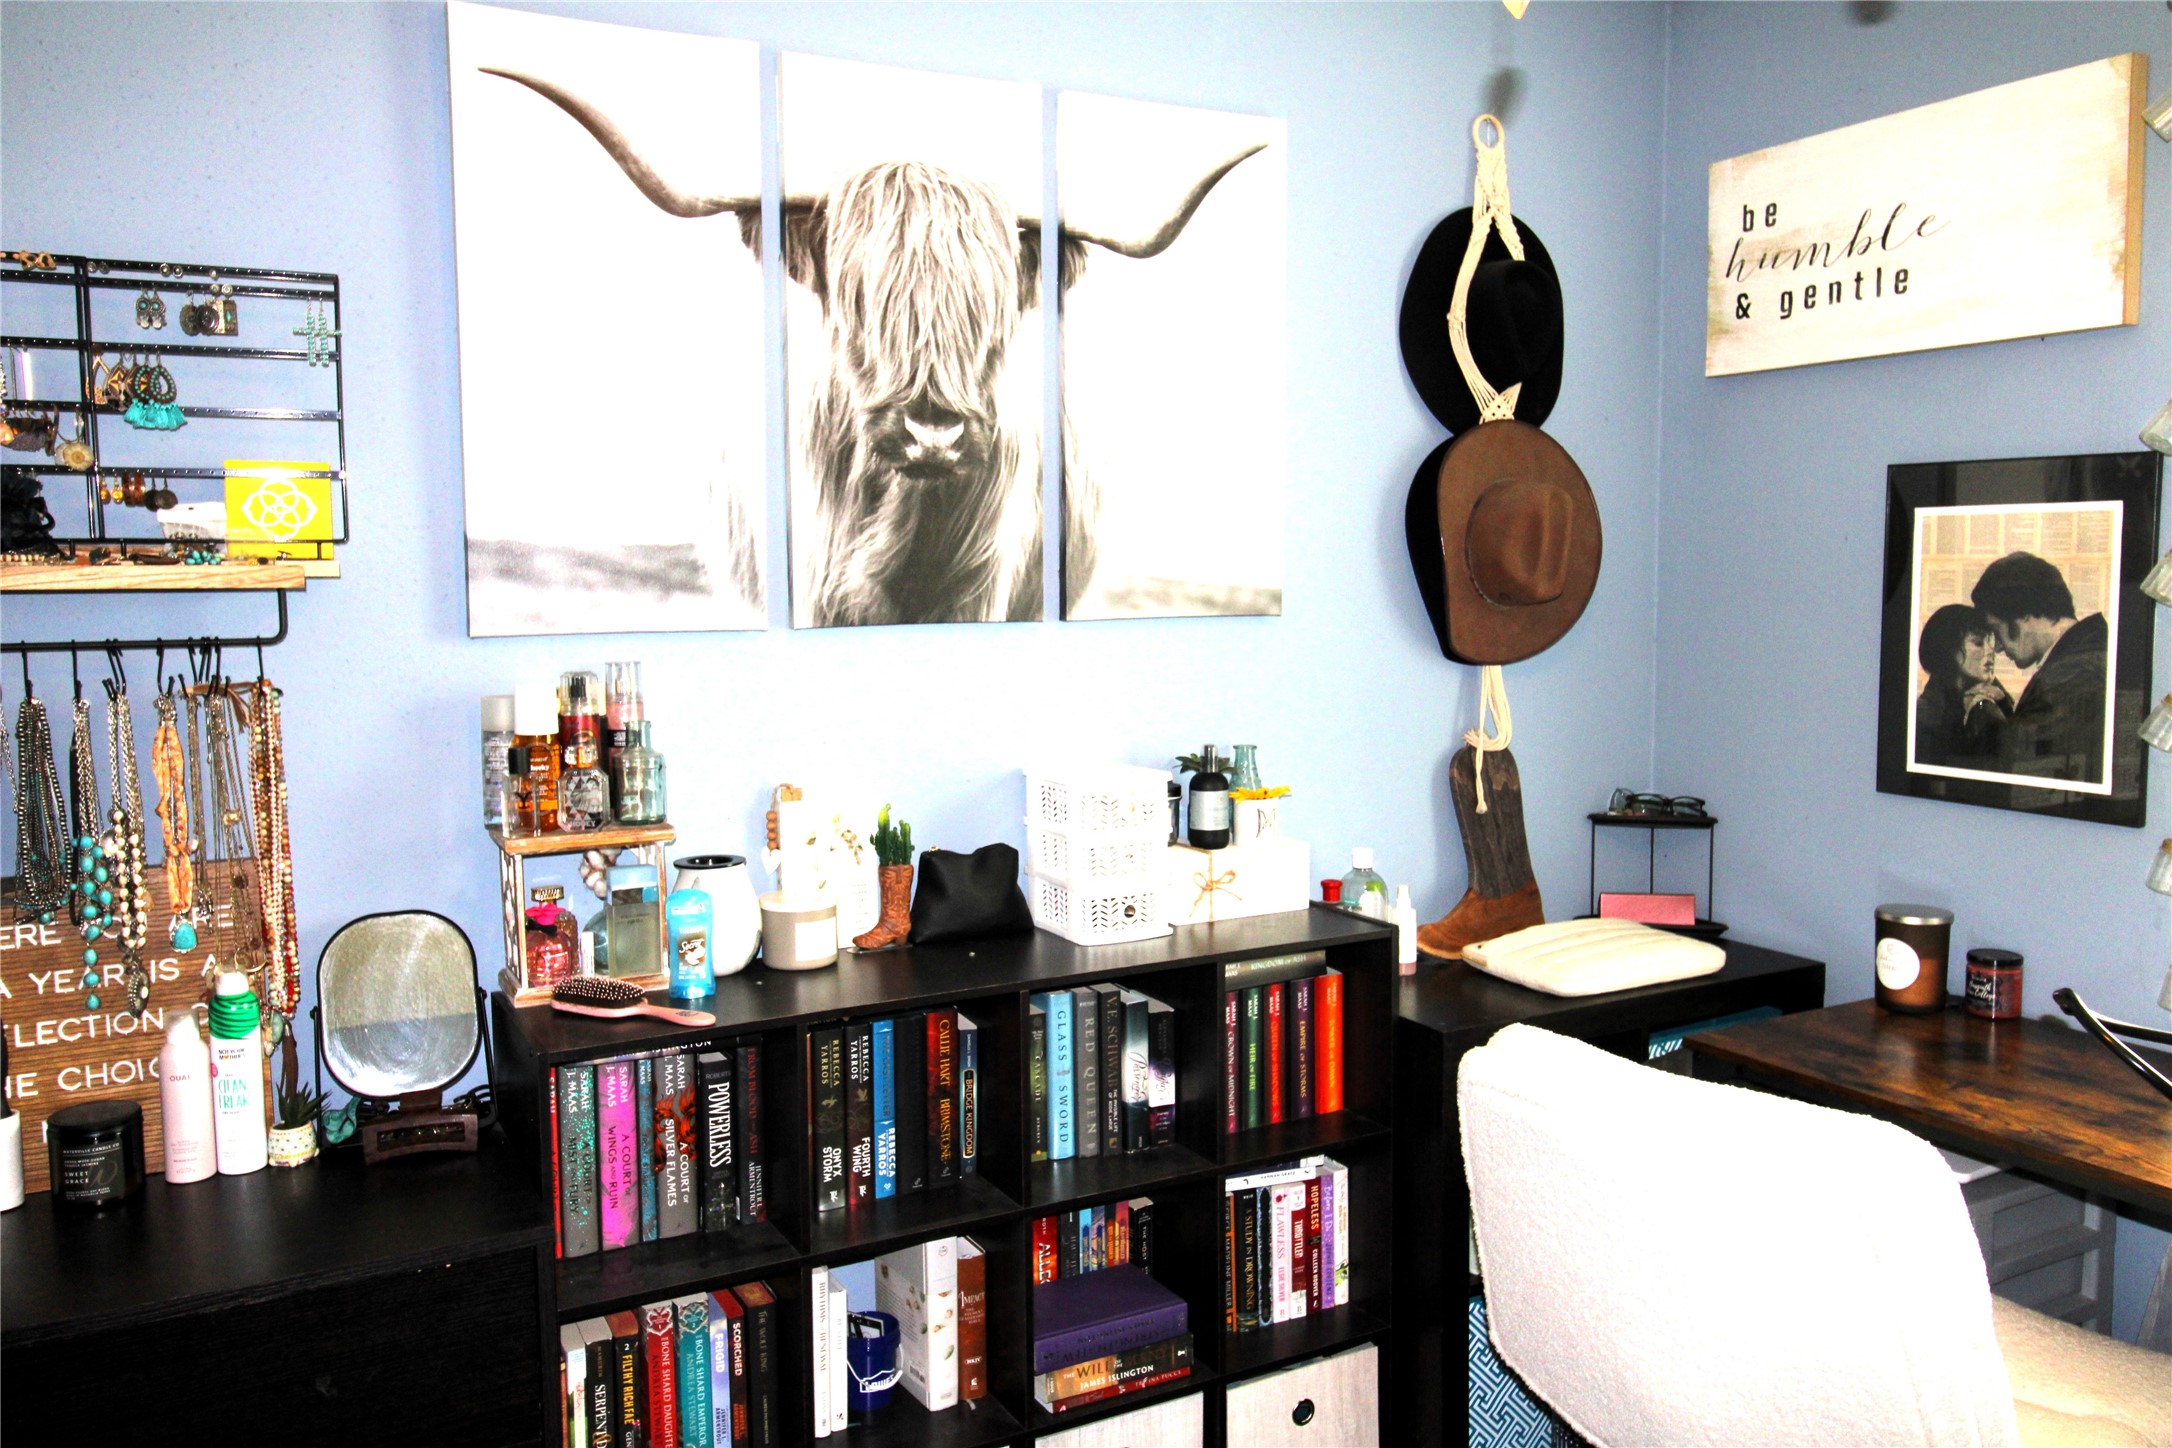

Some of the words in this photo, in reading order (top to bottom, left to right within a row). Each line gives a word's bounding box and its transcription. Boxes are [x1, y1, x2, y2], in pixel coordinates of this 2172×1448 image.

[1742, 201, 1778, 233] be
[1725, 201, 1951, 283] humble
[1735, 292, 1752, 320] &
[1779, 268, 1910, 320] gentle
[679, 938, 704, 953] Secret
[1251, 959, 1283, 970] KINGDOM
[1292, 955, 1306, 963] ASH
[29, 964, 124, 994] YEAR
[150, 958, 180, 983] IS
[4, 1007, 164, 1048] LECTION
[940, 1020, 950, 1056] CALLIE
[1058, 1011, 1067, 1061] GLASS
[1085, 1018, 1095, 1052] RED
[677, 1055, 686, 1089] SARAH
[706, 1071, 730, 1080] ROBERTS
[940, 1058, 950, 1086] HART
[1108, 1028, 1118, 1087] SCHWAB
[568, 1082, 578, 1113] MAAS
[580, 1072, 590, 1110] SARAH
[608, 1077, 616, 1107] MAAS
[620, 1066, 628, 1102] SARAH
[665, 1065, 674, 1096] MAAS
[1059, 1086, 1068, 1142] SWORD
[1084, 1067, 1096, 1133] QUEEN
[622, 1134, 629, 1142] A
[665, 1119, 675, 1157] SILVER
[708, 1082, 732, 1168] POWERLESS
[940, 1098, 950, 1161] BRIMSTONE
[568, 1137, 578, 1164] MIST
[608, 1126, 617, 1164] WINGS
[680, 1142, 688, 1150] A
[750, 1134, 758, 1154] ASH
[853, 1145, 861, 1172] WING
[862, 1137, 870, 1177] FOURTH
[878, 1133, 886, 1176] YARROS
[888, 1128, 896, 1177] REBECCA
[582, 1154, 592, 1193] COURT
[622, 1146, 631, 1184] COURT
[680, 1154, 689, 1192] COURT
[823, 1147, 832, 1182] STORM
[833, 1148, 842, 1177] ONYX
[569, 1185, 579, 1214] FURY
[609, 1182, 618, 1209] RUIN
[666, 1161, 676, 1206] FLAMES
[1324, 1185, 1332, 1210] Before
[1311, 1185, 1319, 1230] HOPELESS
[1245, 1216, 1253, 1244] STUDY
[1276, 1207, 1286, 1259] FLAWLESS
[1294, 1220, 1303, 1258] THROTTLED
[1245, 1257, 1255, 1310] DROWNING
[759, 1310, 767, 1323] THE
[661, 1341, 670, 1366] BONE
[695, 1340, 704, 1364] BONE
[715, 1333, 725, 1373] FRIGID
[733, 1322, 743, 1376] SCORCHED
[760, 1352, 768, 1372] KING
[623, 1355, 633, 1385] FILTHY
[662, 1369, 671, 1402] SHARD
[687, 1354, 695, 1393] ANDREA
[696, 1367, 705, 1400] SHARD
[1063, 1372, 1075, 1380] THE
[1077, 1361, 1112, 1379] WILL
[1080, 1378, 1106, 1391] JAMES
[1108, 1365, 1154, 1382] ISLINGTON
[595, 1384, 607, 1435] SERPENT
[624, 1386, 634, 1410] RICH
[688, 1396, 697, 1436] STEWART
[624, 1409, 634, 1424] FAE
[664, 1404, 673, 1448] DAUGHTE
[698, 1404, 707, 1446] EMPEROR
